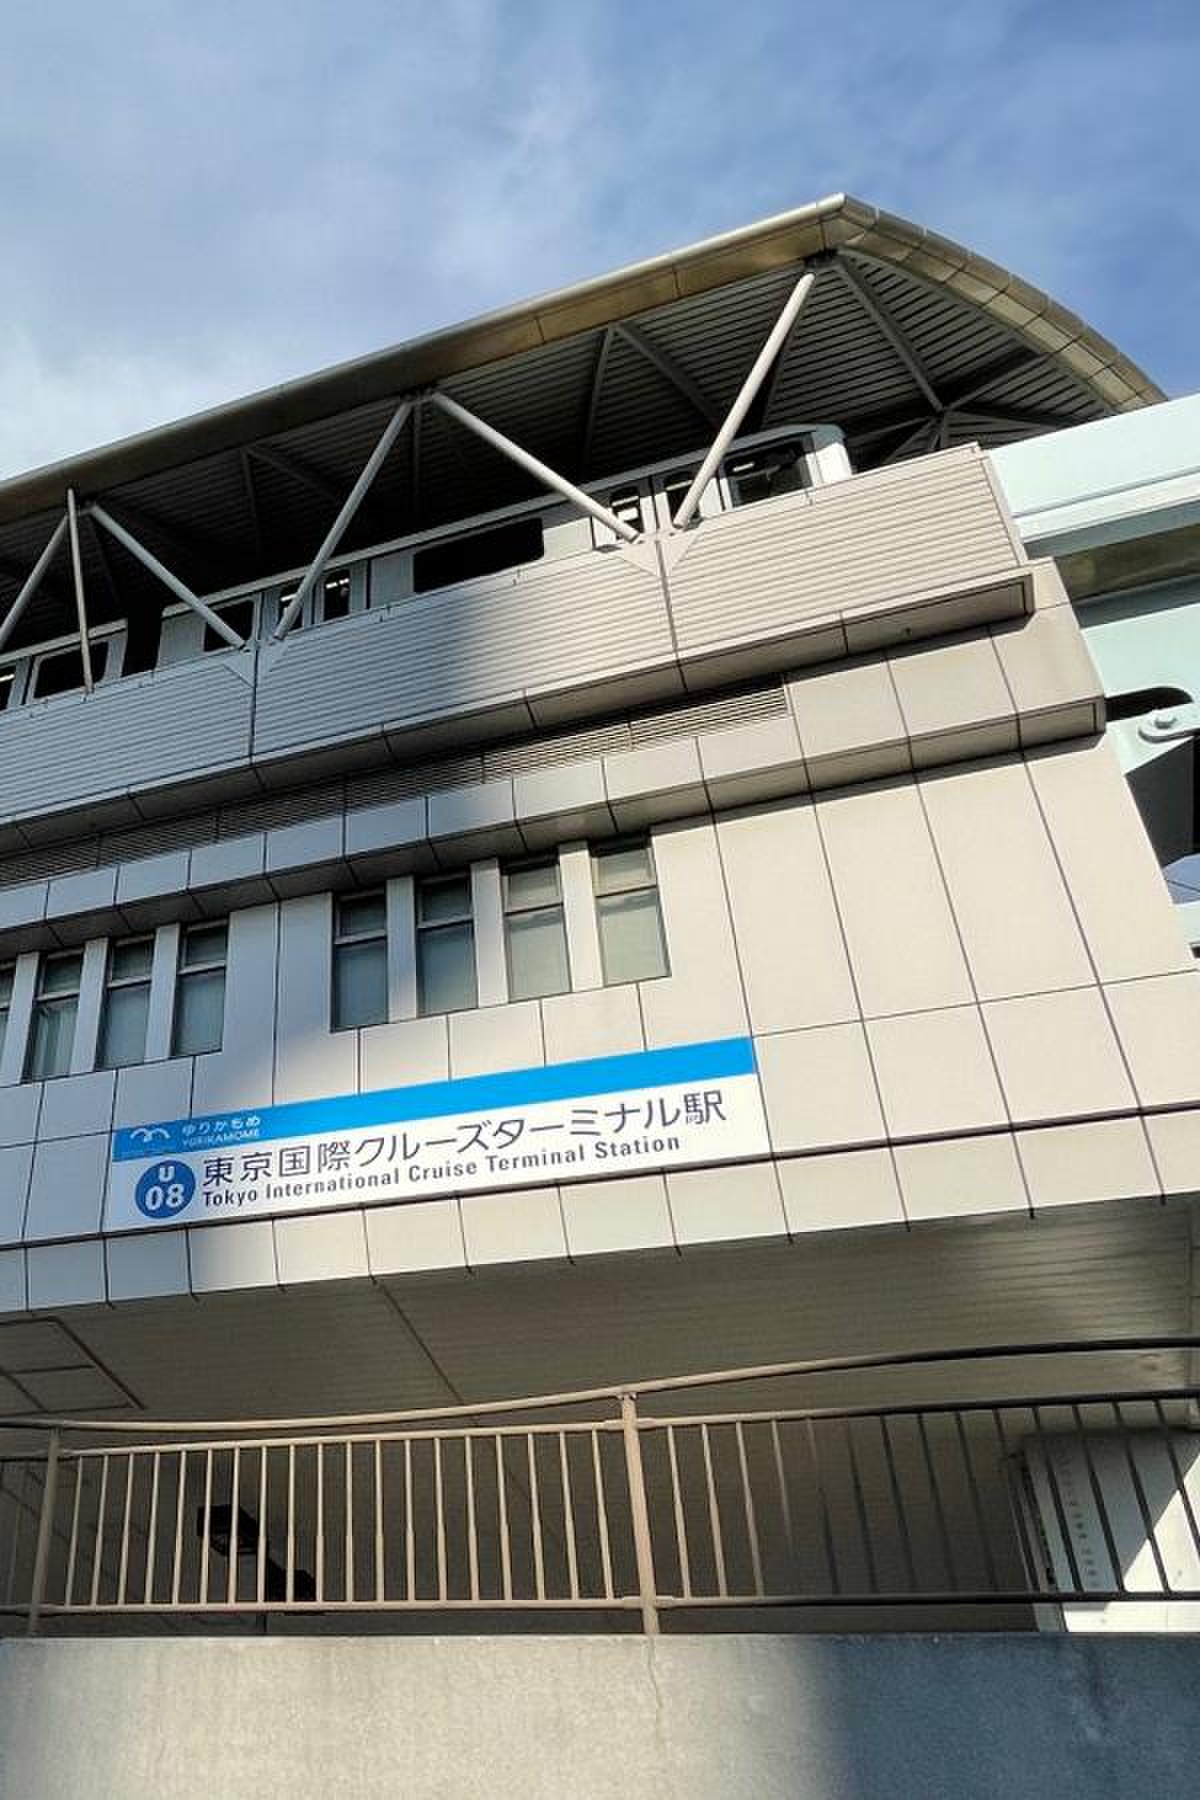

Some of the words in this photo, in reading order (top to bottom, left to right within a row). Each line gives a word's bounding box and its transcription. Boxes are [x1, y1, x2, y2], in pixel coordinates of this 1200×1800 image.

[182, 1115, 261, 1136] ゆりかもめ
[202, 1089, 727, 1187] 東京国際クルーズターミナル駅
[158, 1165, 176, 1182] U
[202, 1188, 257, 1207] Tokyo
[266, 1168, 400, 1200] International
[408, 1161, 478, 1183] Cruise
[485, 1144, 585, 1172] Terminal
[594, 1135, 681, 1160] Station
[145, 1183, 185, 1211] 08
